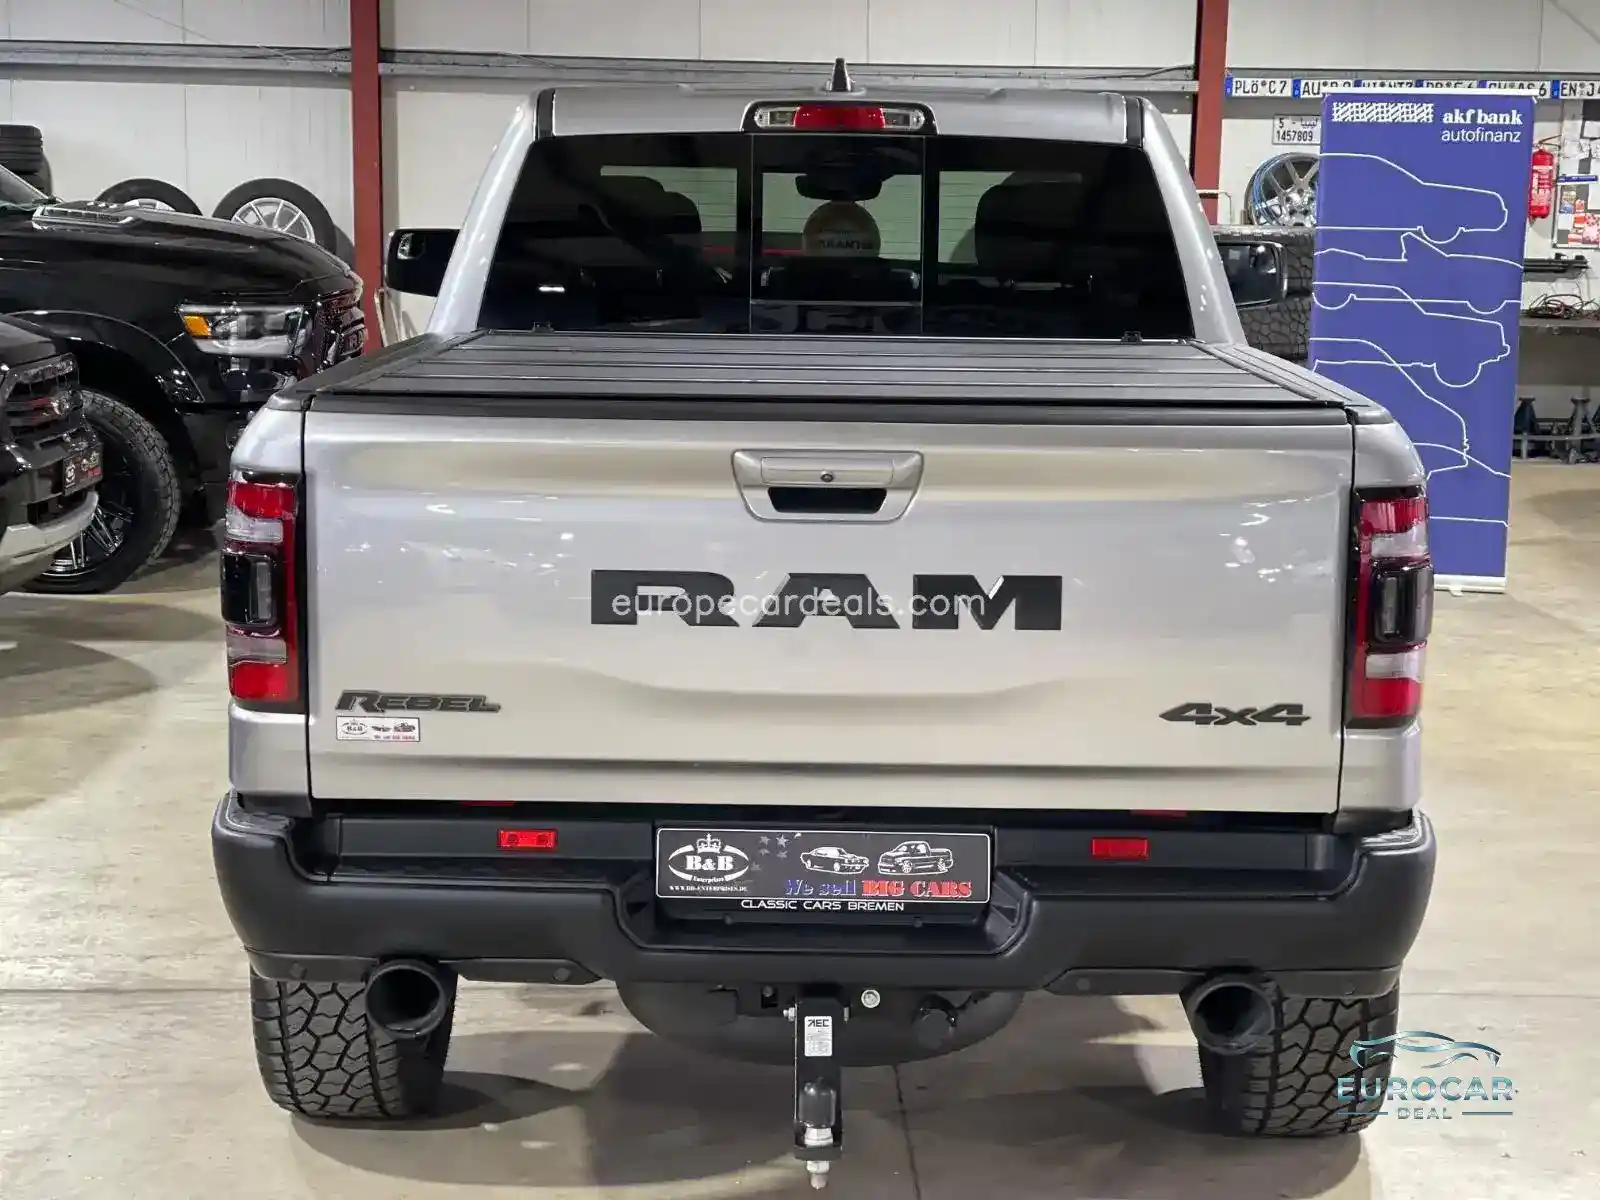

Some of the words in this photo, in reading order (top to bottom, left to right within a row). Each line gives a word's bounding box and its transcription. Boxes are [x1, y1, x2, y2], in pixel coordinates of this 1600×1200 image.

[1442, 109, 1476, 125] akf
[1477, 110, 1523, 125] bank
[1441, 127, 1521, 143] autofinanz
[591, 569, 1063, 631] RAM
[1159, 702, 1312, 726] 4x4
[685, 855, 734, 871] B&B
[784, 879, 814, 896] We
[819, 879, 857, 896] sell
[861, 880, 905, 897] BIG
[910, 881, 973, 898] CARS
[741, 899, 798, 910] CLASSIC
[803, 900, 842, 911] CARS
[847, 901, 905, 912] BREMEN
